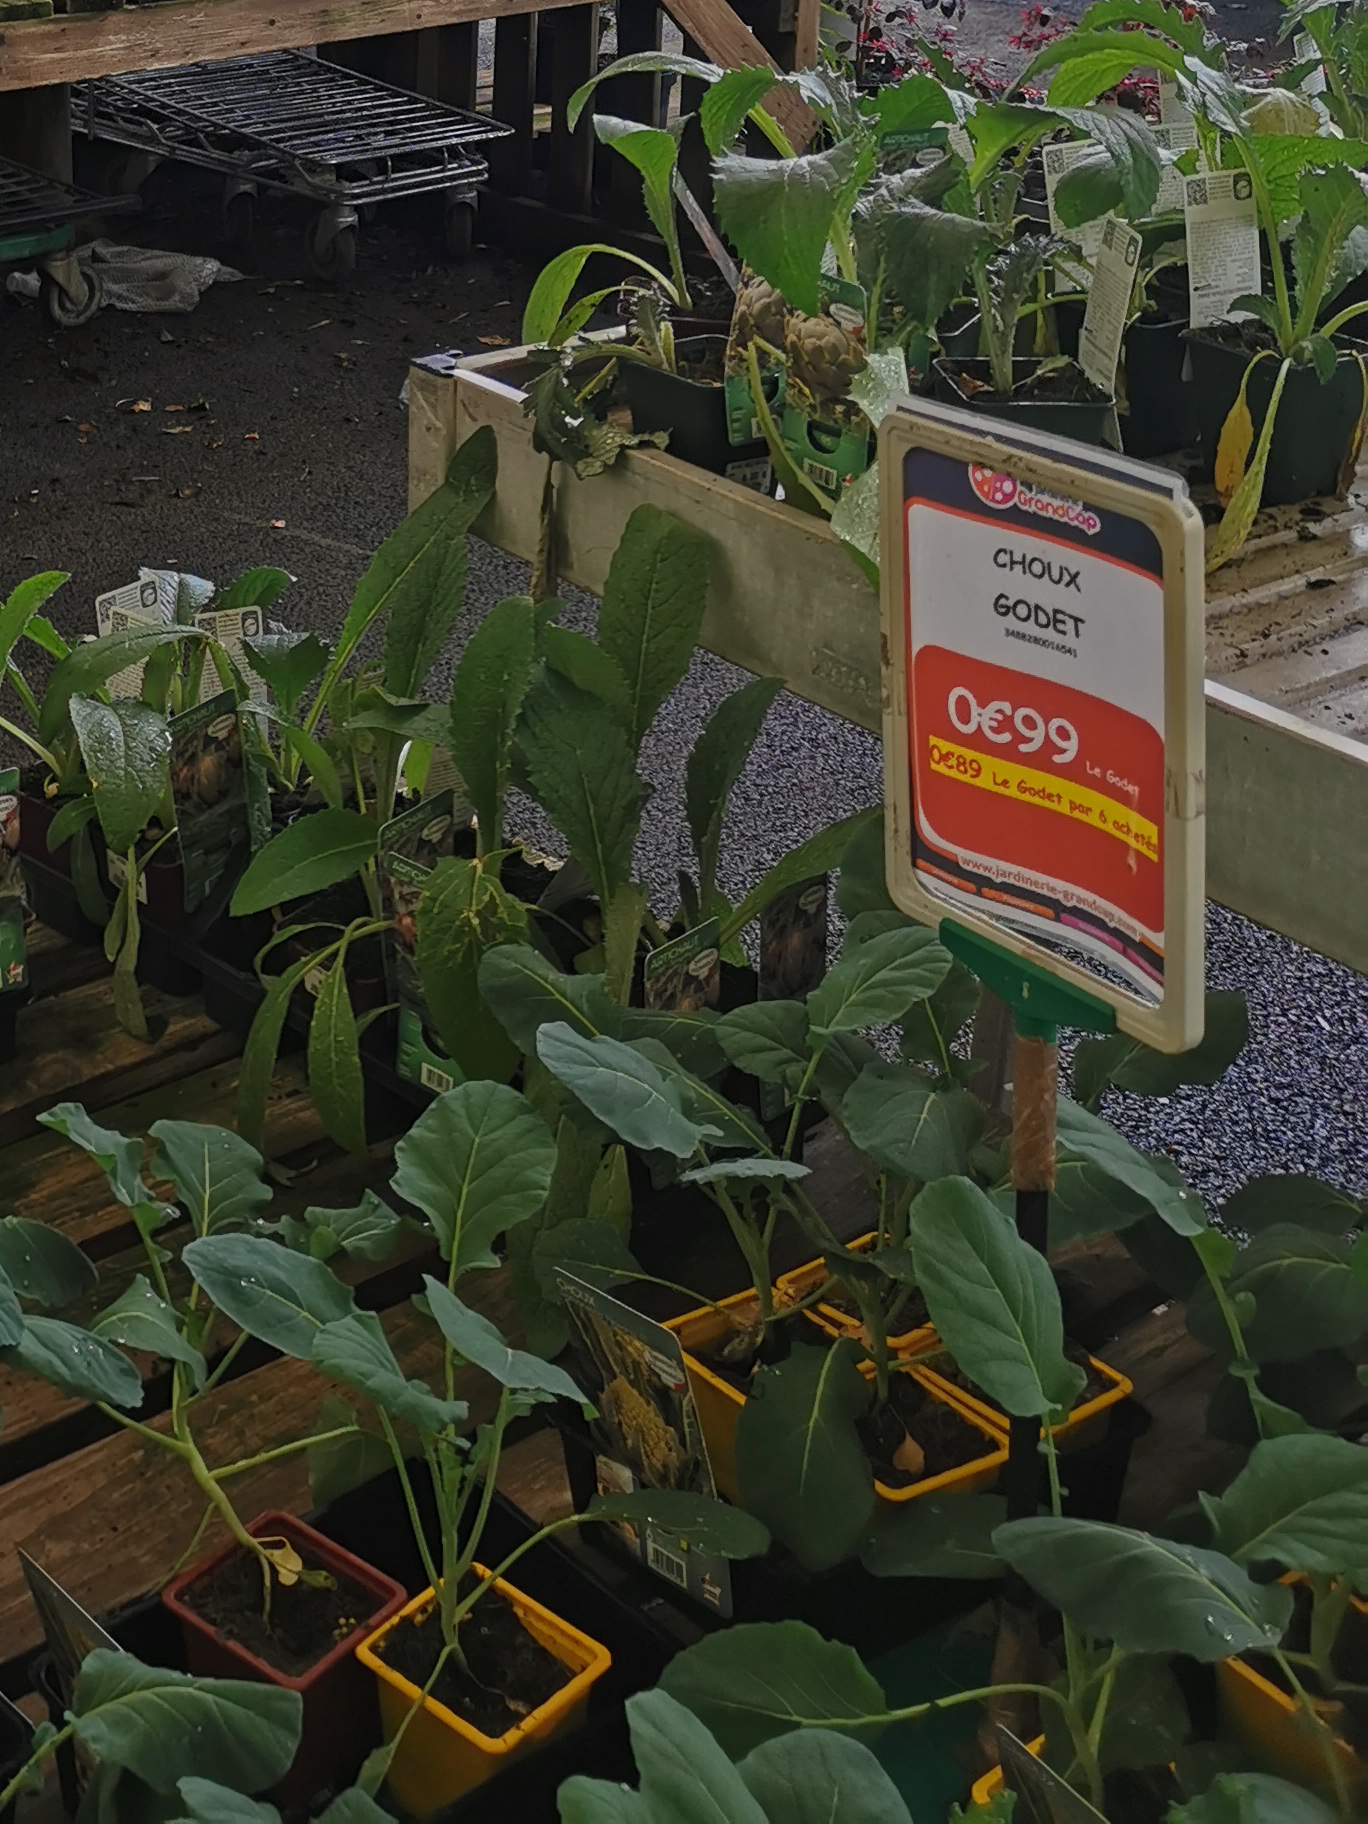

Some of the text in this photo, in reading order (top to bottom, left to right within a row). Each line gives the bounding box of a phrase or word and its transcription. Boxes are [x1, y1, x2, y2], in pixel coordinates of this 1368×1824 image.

[993, 547, 1083, 593] CHOUX
[993, 593, 1086, 639] GODET
[947, 686, 1079, 764] 0€99
[929, 744, 983, 780] 0€89
[992, 772, 1010, 790] Le
[1016, 781, 1063, 806] Godet
[1068, 799, 1093, 818] par
[1098, 809, 1107, 825] 6
[1105, 772, 1140, 795] Godet
